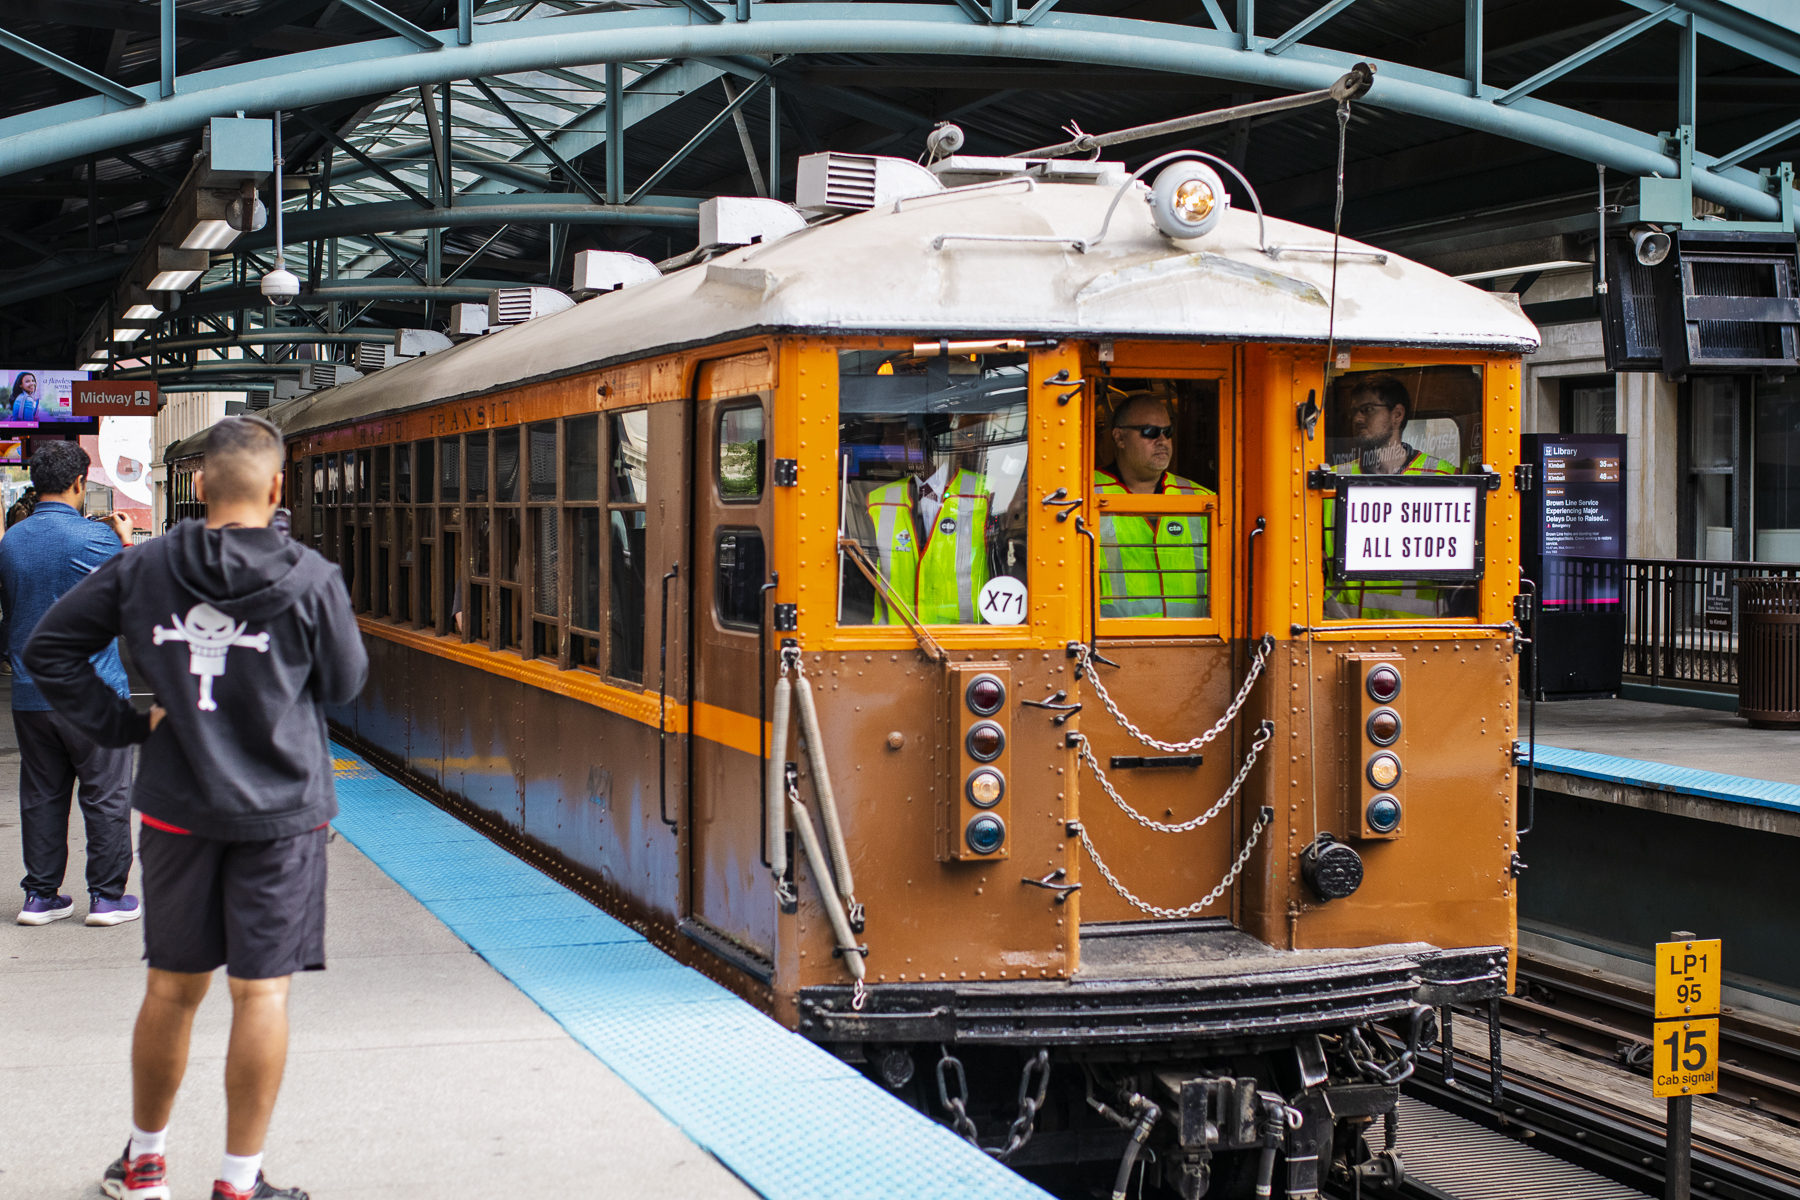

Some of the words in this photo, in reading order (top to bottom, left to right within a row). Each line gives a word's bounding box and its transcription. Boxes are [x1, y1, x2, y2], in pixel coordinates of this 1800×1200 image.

[80, 391, 132, 407] Midway
[360, 421, 402, 445] RAPID
[429, 400, 511, 434] TRANSIT
[1553, 446, 1577, 456] Library
[1599, 460, 1607, 468] 35
[1351, 502, 1392, 523] LOOP
[1401, 502, 1472, 523] SHUTTLE
[1545, 507, 1582, 515] Experiencing
[1582, 507, 1599, 515] Major
[1545, 515, 1565, 523] Delays
[941, 522, 954, 530] cta
[1363, 537, 1392, 558] ALL
[1401, 536, 1457, 558] STOPS
[1713, 571, 1726, 596] H
[985, 590, 1024, 615] X71
[1670, 953, 1707, 975] LP1
[1677, 983, 1702, 1004] 95
[1663, 1030, 1707, 1072] 15
[1657, 1073, 1679, 1087] Cab
[1682, 1070, 1714, 1087] signal
